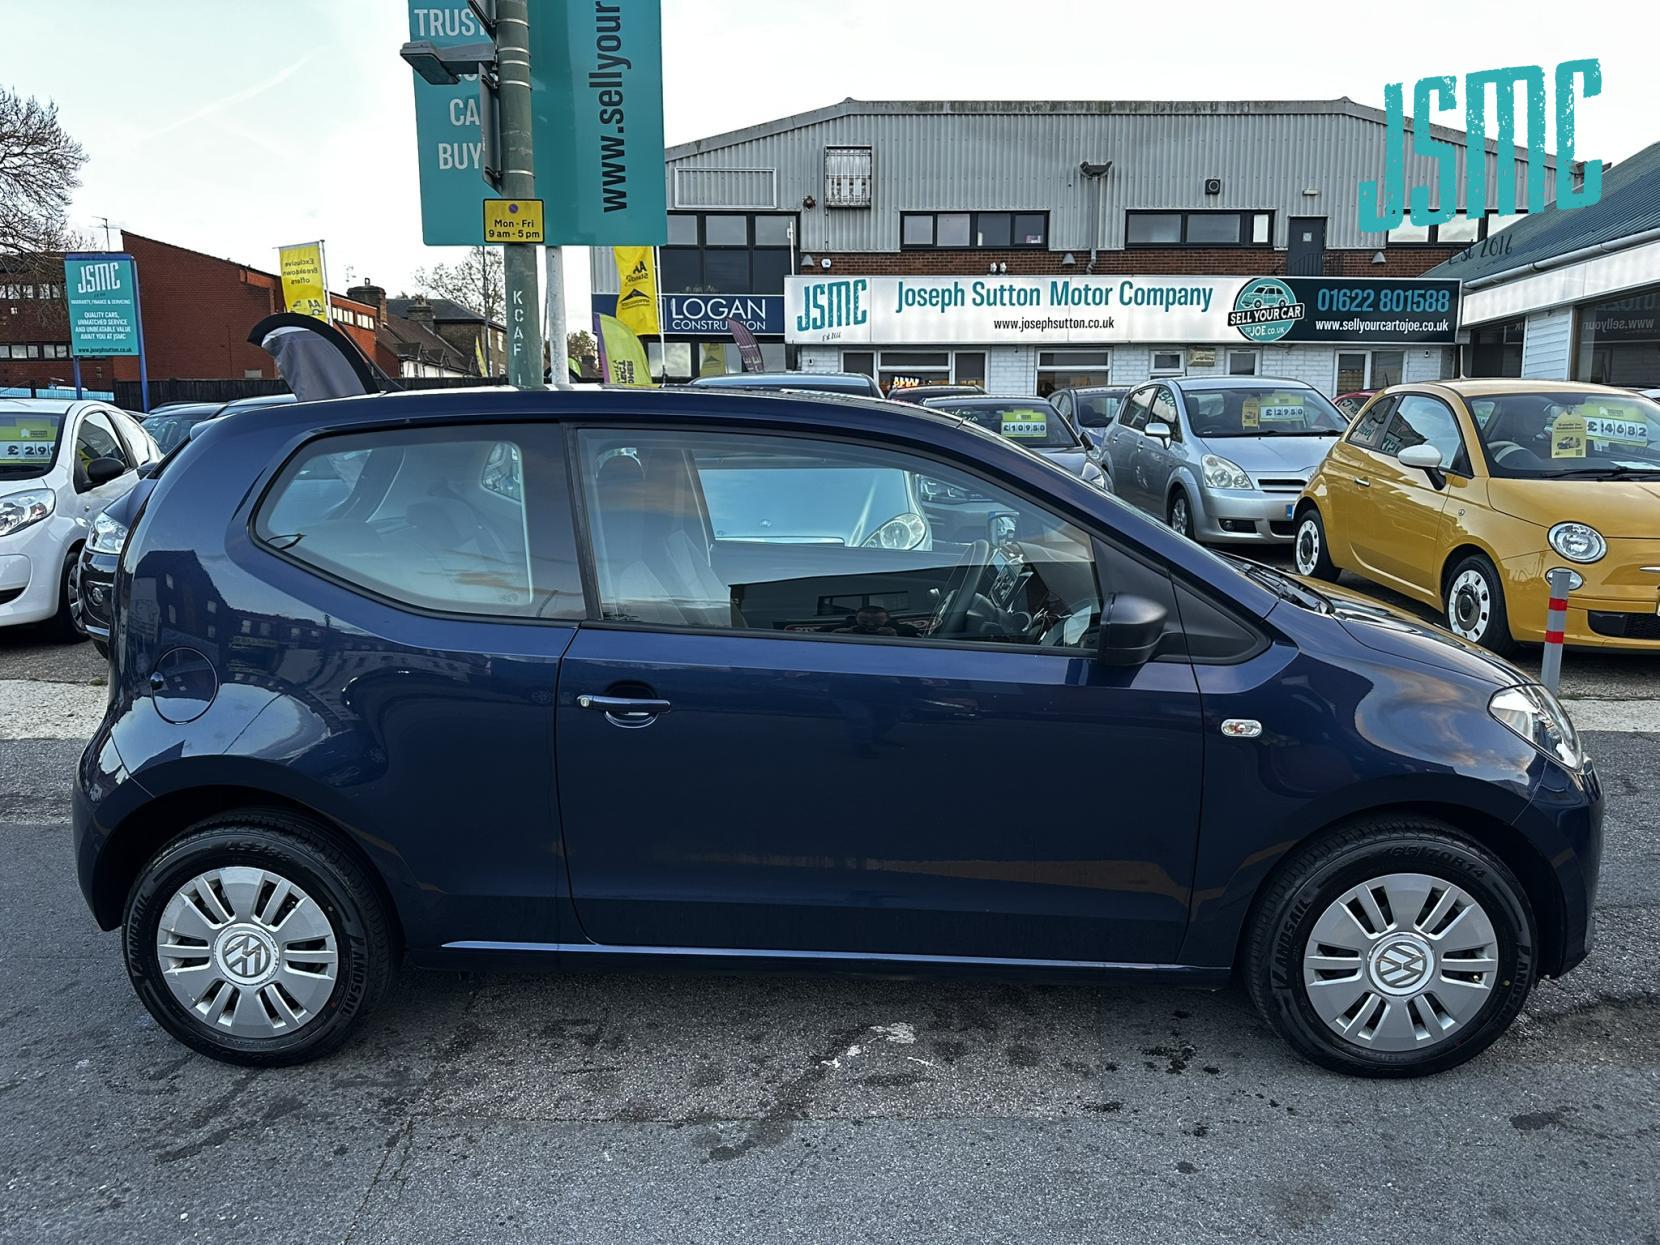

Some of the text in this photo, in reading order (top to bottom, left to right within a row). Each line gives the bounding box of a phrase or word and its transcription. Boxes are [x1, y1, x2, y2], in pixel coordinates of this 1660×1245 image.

[494, 219, 514, 228] Mon
[521, 219, 535, 228] Fri
[525, 231, 540, 240] pm
[78, 262, 121, 293] JSMC
[796, 278, 868, 333] JSMC
[896, 280, 1213, 314] Joseph Sutton Motor Company
[1317, 288, 1450, 313] 01622 801588
[672, 298, 766, 320] LOGAN
[1230, 306, 1301, 325] SELL YOUR CAR
[672, 320, 766, 330] CONSTRUON
[994, 316, 1115, 333] www.josephsutton.co.uk
[1315, 317, 1449, 335] www.sellyourcartojoe.co.uk
